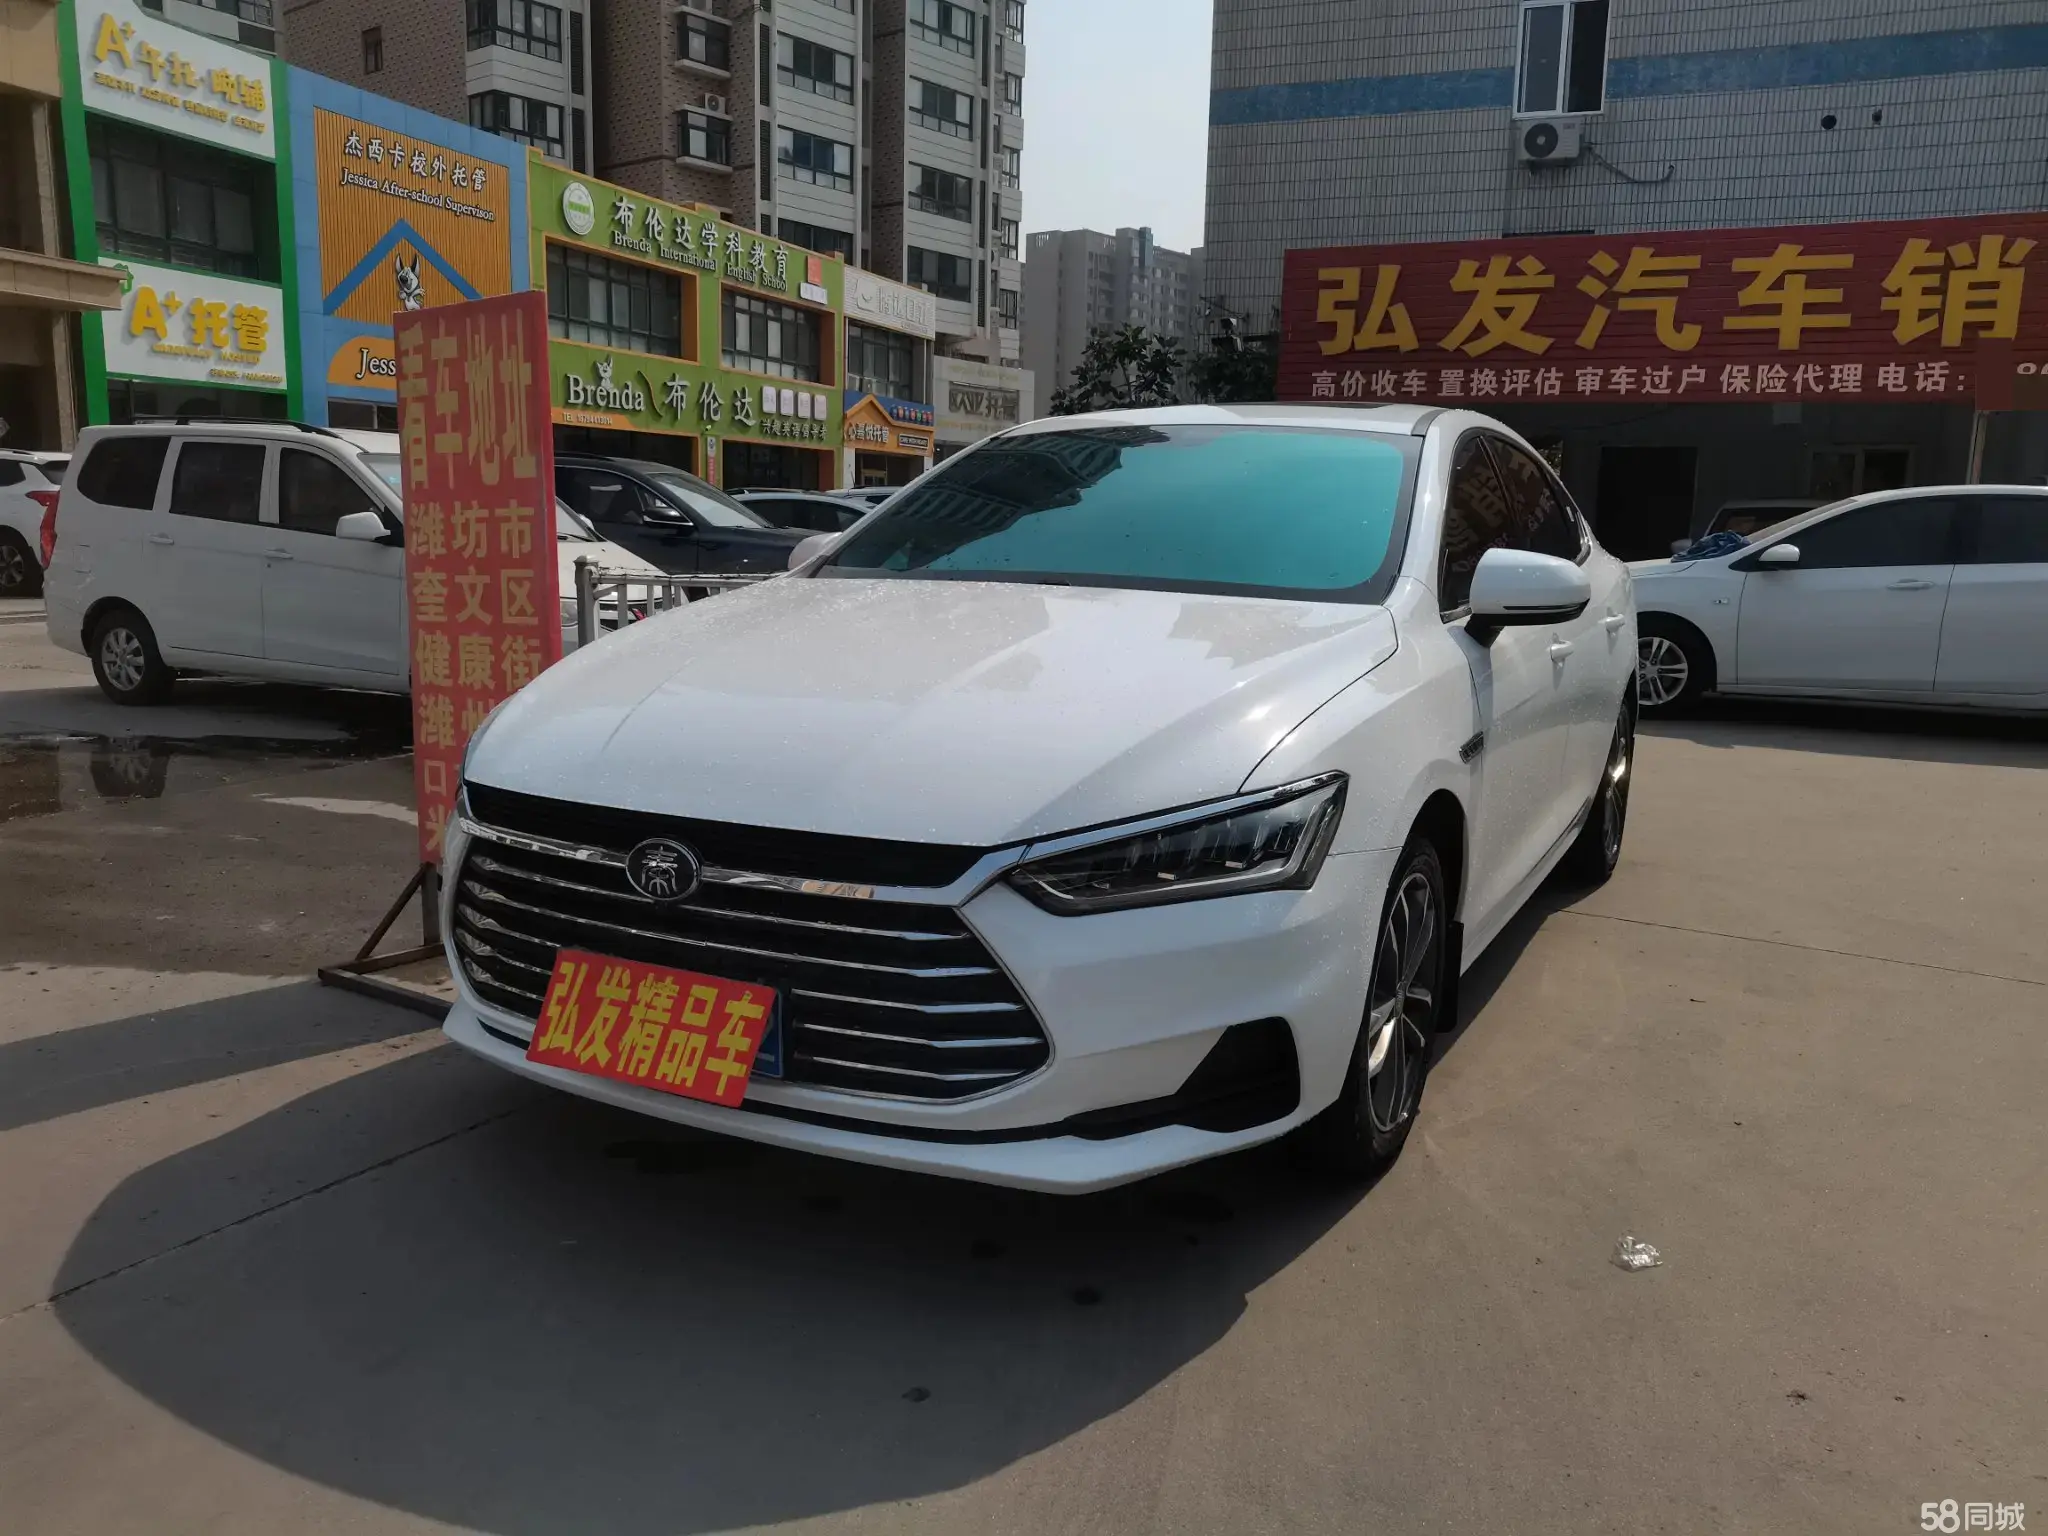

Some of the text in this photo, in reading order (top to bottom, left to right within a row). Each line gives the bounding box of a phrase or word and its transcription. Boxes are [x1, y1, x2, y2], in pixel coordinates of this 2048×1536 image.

[345, 131, 487, 191] 杰西卡校外托管
[341, 168, 495, 221] Jessica After-school Supervison
[614, 196, 789, 280] 布伦达学科教育
[614, 230, 788, 292] Brenda International English School
[1315, 234, 2039, 356] 弘发汽车销
[356, 348, 397, 379] Jess
[566, 373, 645, 412] Brenda
[1311, 369, 1428, 397] 高价收车
[1437, 366, 1564, 397] 置换评估
[1575, 364, 1707, 396] 审车过户
[1719, 362, 1864, 394] 保险代理
[399, 308, 538, 491] 看车地址
[664, 373, 756, 427] 布伦达
[410, 499, 535, 560] 潍坊市
[412, 565, 539, 626] 奎文区
[415, 628, 543, 692] 健康街
[537, 960, 766, 1097] 弘发精品车
